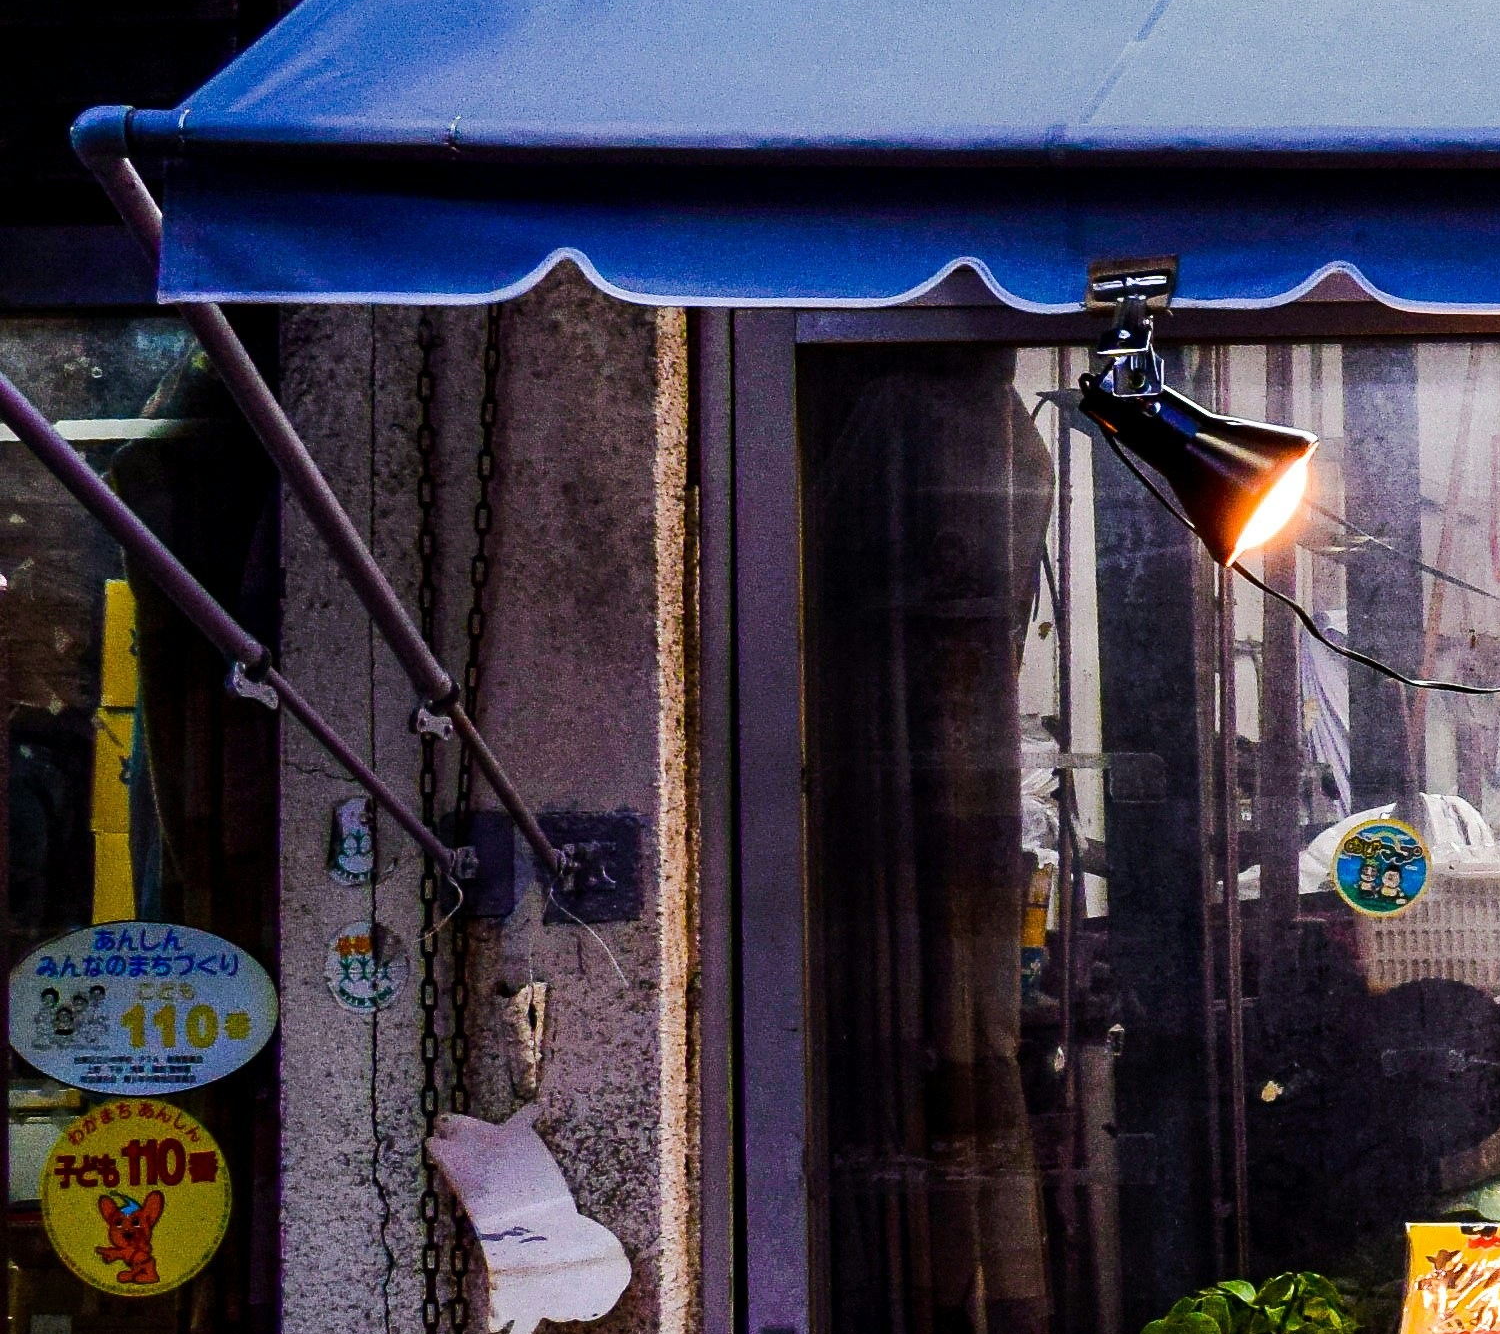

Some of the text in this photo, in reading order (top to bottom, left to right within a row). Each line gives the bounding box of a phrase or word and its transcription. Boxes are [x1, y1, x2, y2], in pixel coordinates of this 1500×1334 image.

[94, 929, 183, 953] あんしん
[35, 952, 241, 979] みんなのまちづくり
